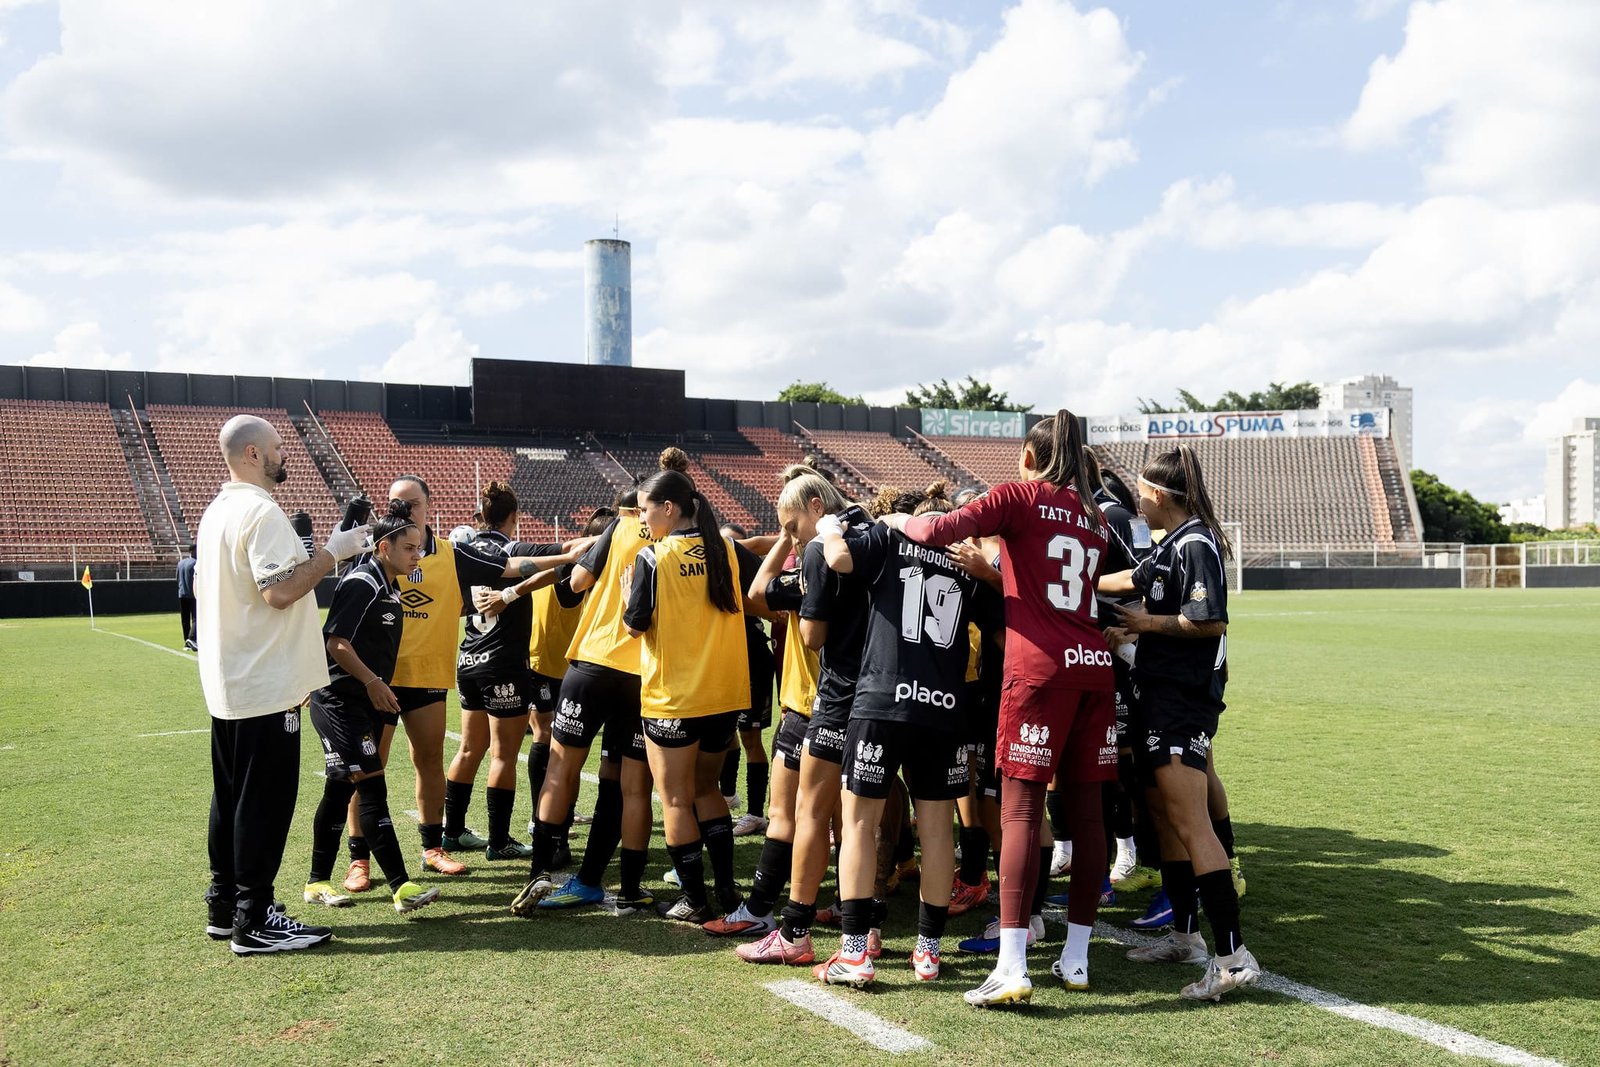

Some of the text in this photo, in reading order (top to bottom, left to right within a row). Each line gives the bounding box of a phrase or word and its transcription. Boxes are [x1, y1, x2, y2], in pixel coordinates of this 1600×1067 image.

[949, 415, 1023, 438] Sicredi
[1091, 422, 1142, 433] COLCHÕES
[1038, 505, 1072, 523] TATY
[1046, 534, 1100, 619] 31
[403, 610, 429, 620] mbro
[899, 566, 963, 650] 19
[1064, 644, 1113, 668] placo
[895, 680, 956, 710] placo
[1008, 756, 1027, 764] SANTA
[1010, 743, 1052, 757] UNISANTA
